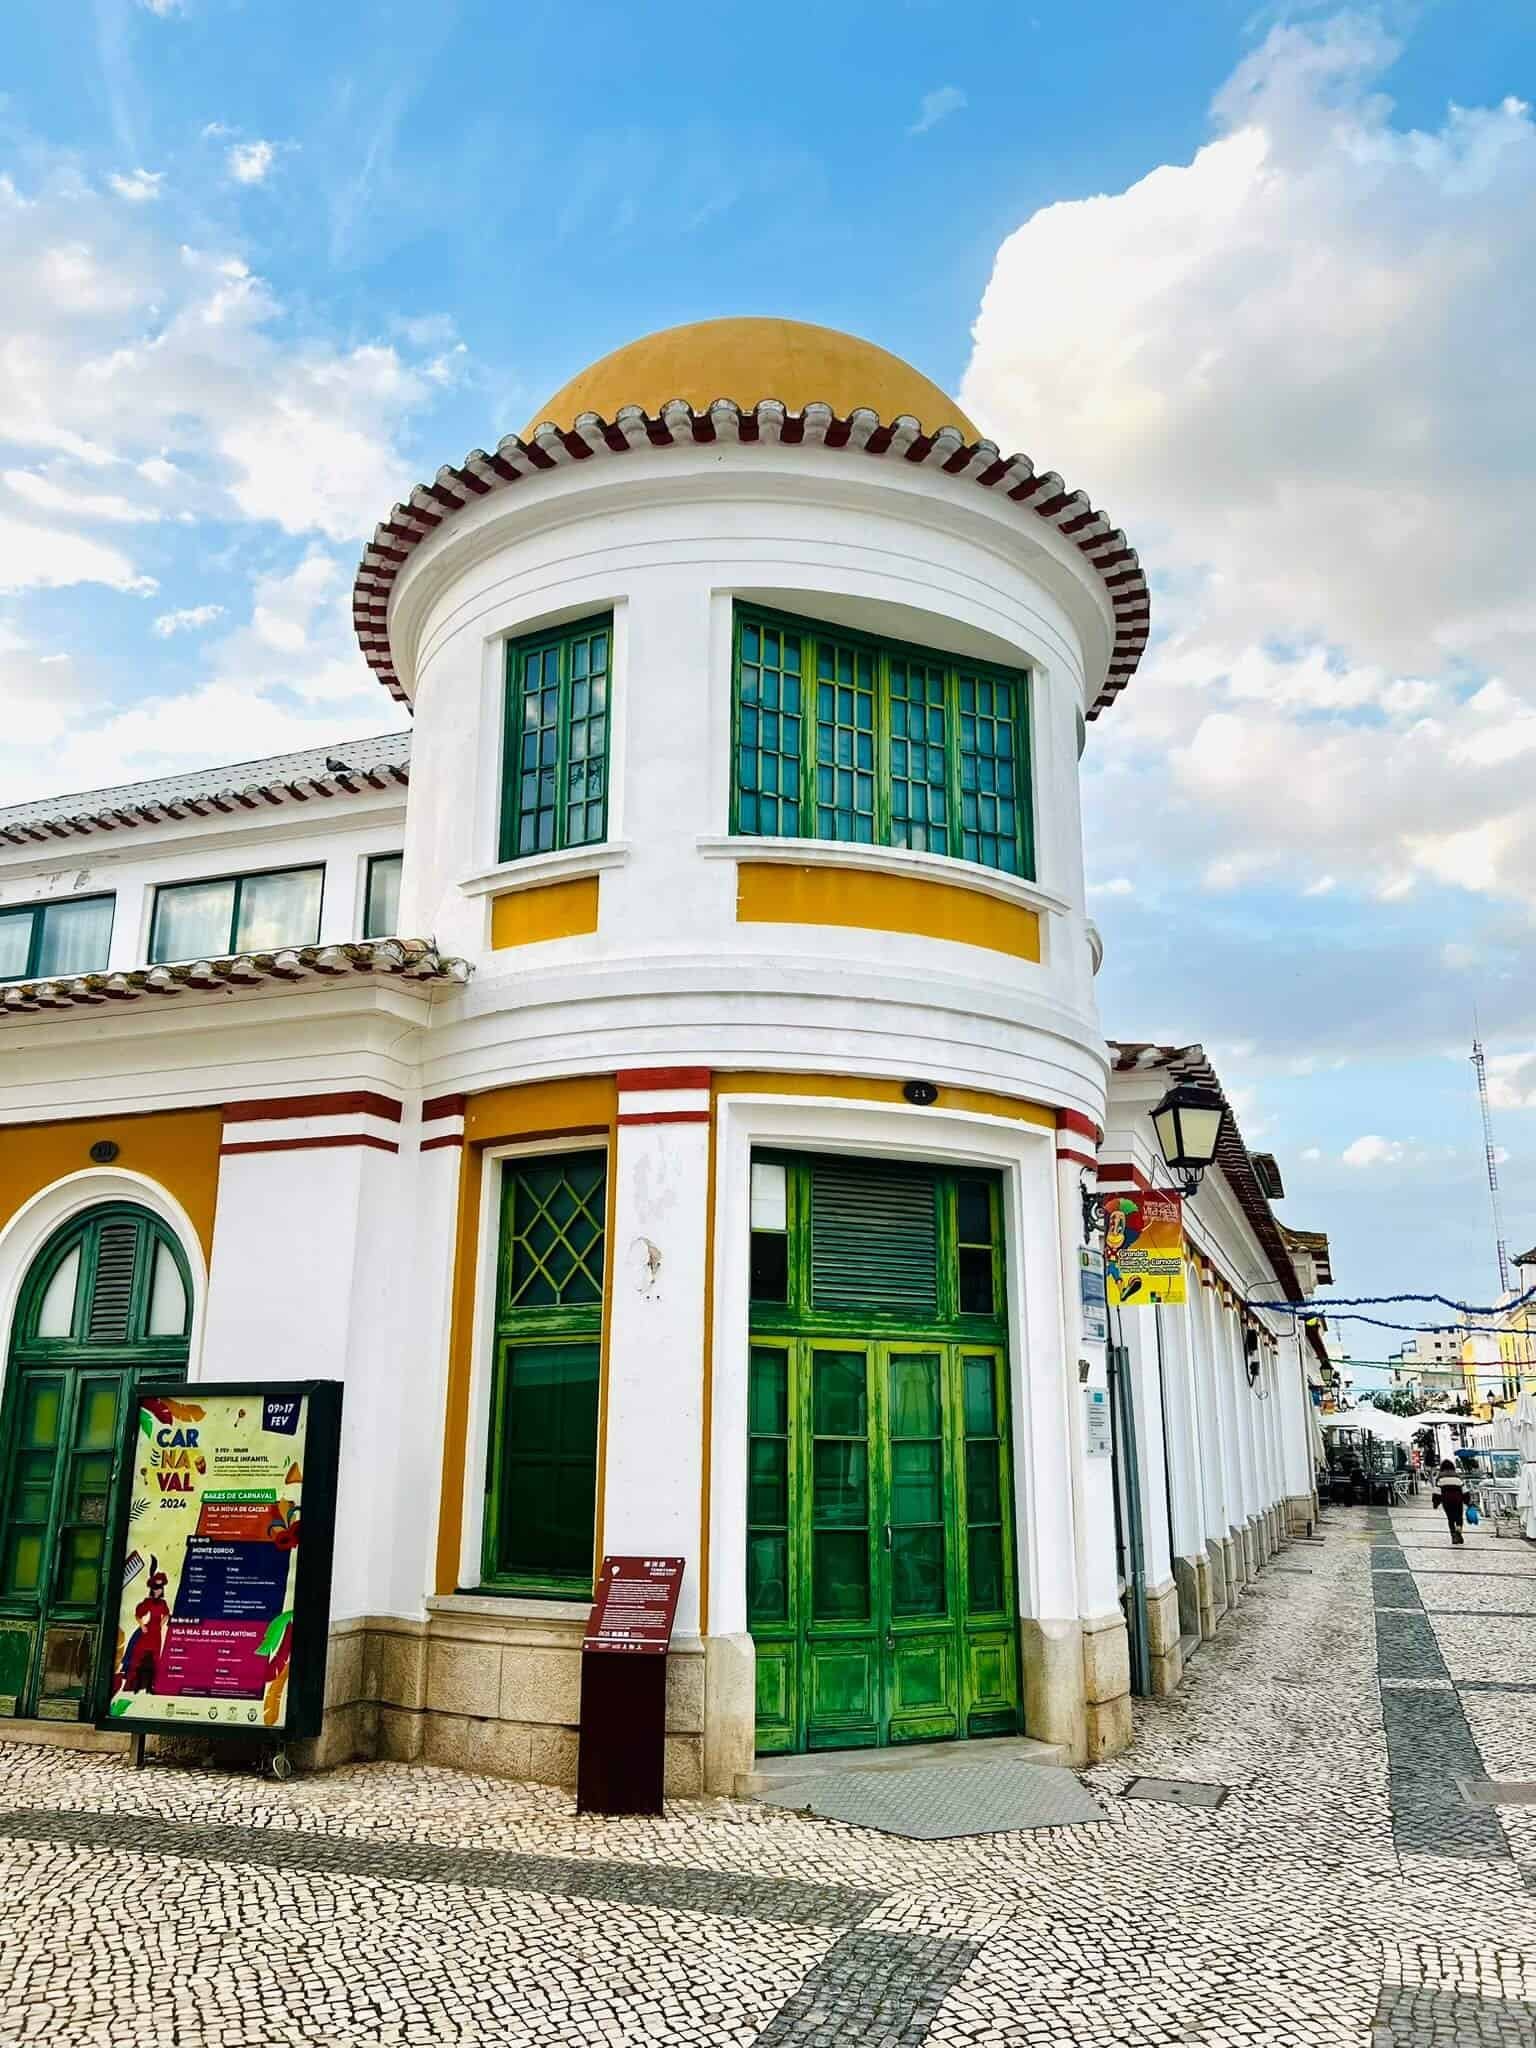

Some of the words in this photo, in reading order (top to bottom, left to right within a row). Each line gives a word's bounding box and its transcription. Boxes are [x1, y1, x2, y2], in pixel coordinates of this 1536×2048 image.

[271, 1416, 289, 1427] FEV
[157, 1428, 199, 1448] CAR
[160, 1450, 190, 1469] NA
[215, 1455, 239, 1463] DESFILE
[240, 1455, 269, 1463] INFANTIL
[157, 1472, 194, 1492] VAL
[160, 1499, 187, 1509] 2024
